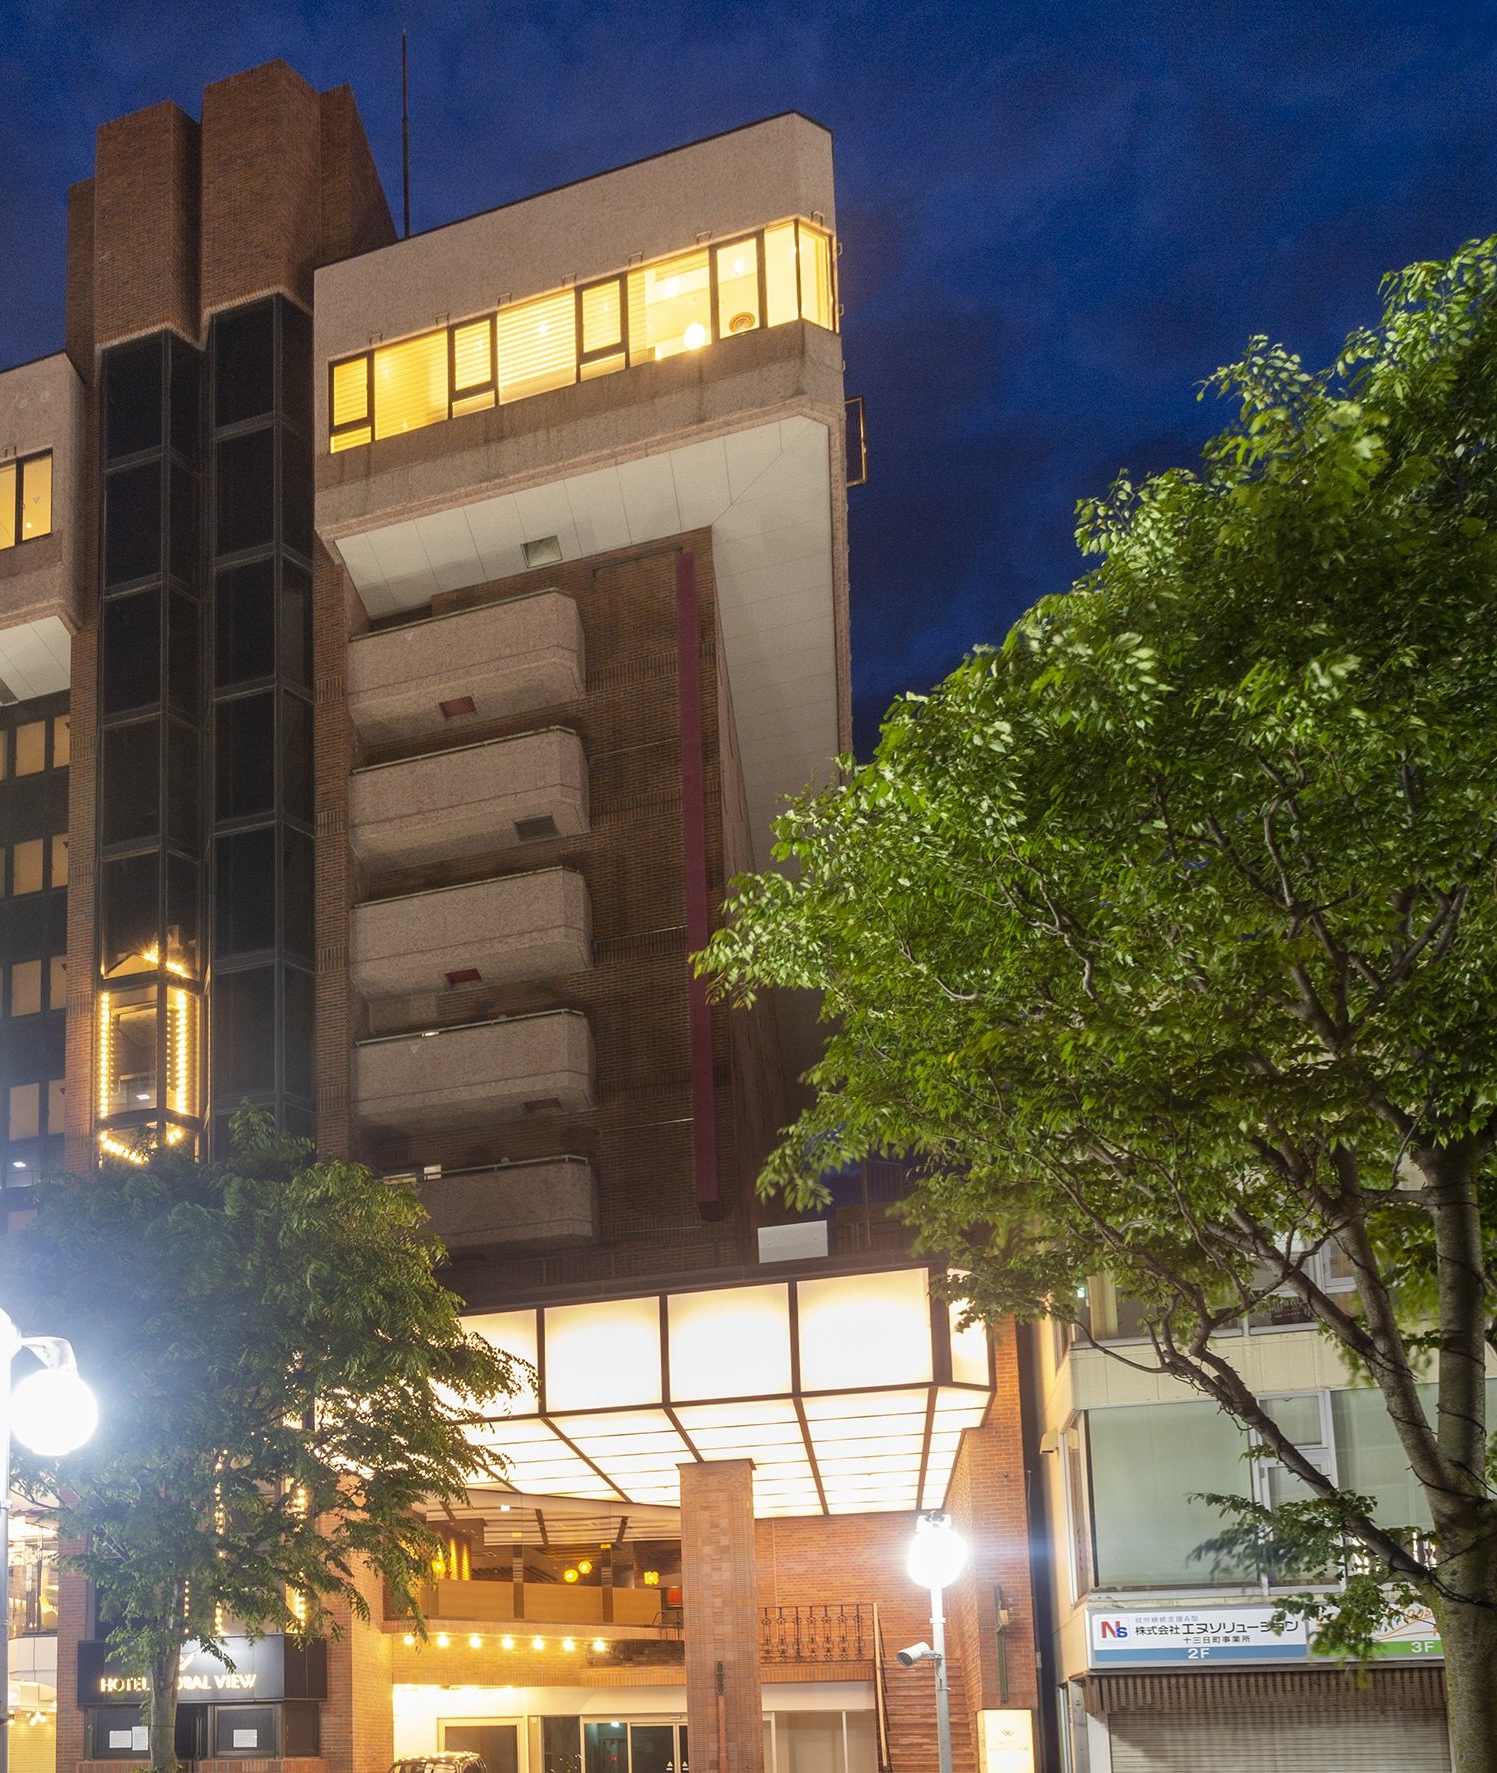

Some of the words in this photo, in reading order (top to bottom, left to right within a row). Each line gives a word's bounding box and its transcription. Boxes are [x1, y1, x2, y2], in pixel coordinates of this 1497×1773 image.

[1183, 1635, 1251, 1644] 十三日町事業所
[1411, 1641, 1435, 1653] 3F
[1187, 1648, 1210, 1659] 2F
[100, 1676, 150, 1693] HOTEL
[213, 1673, 257, 1689] VIEW
